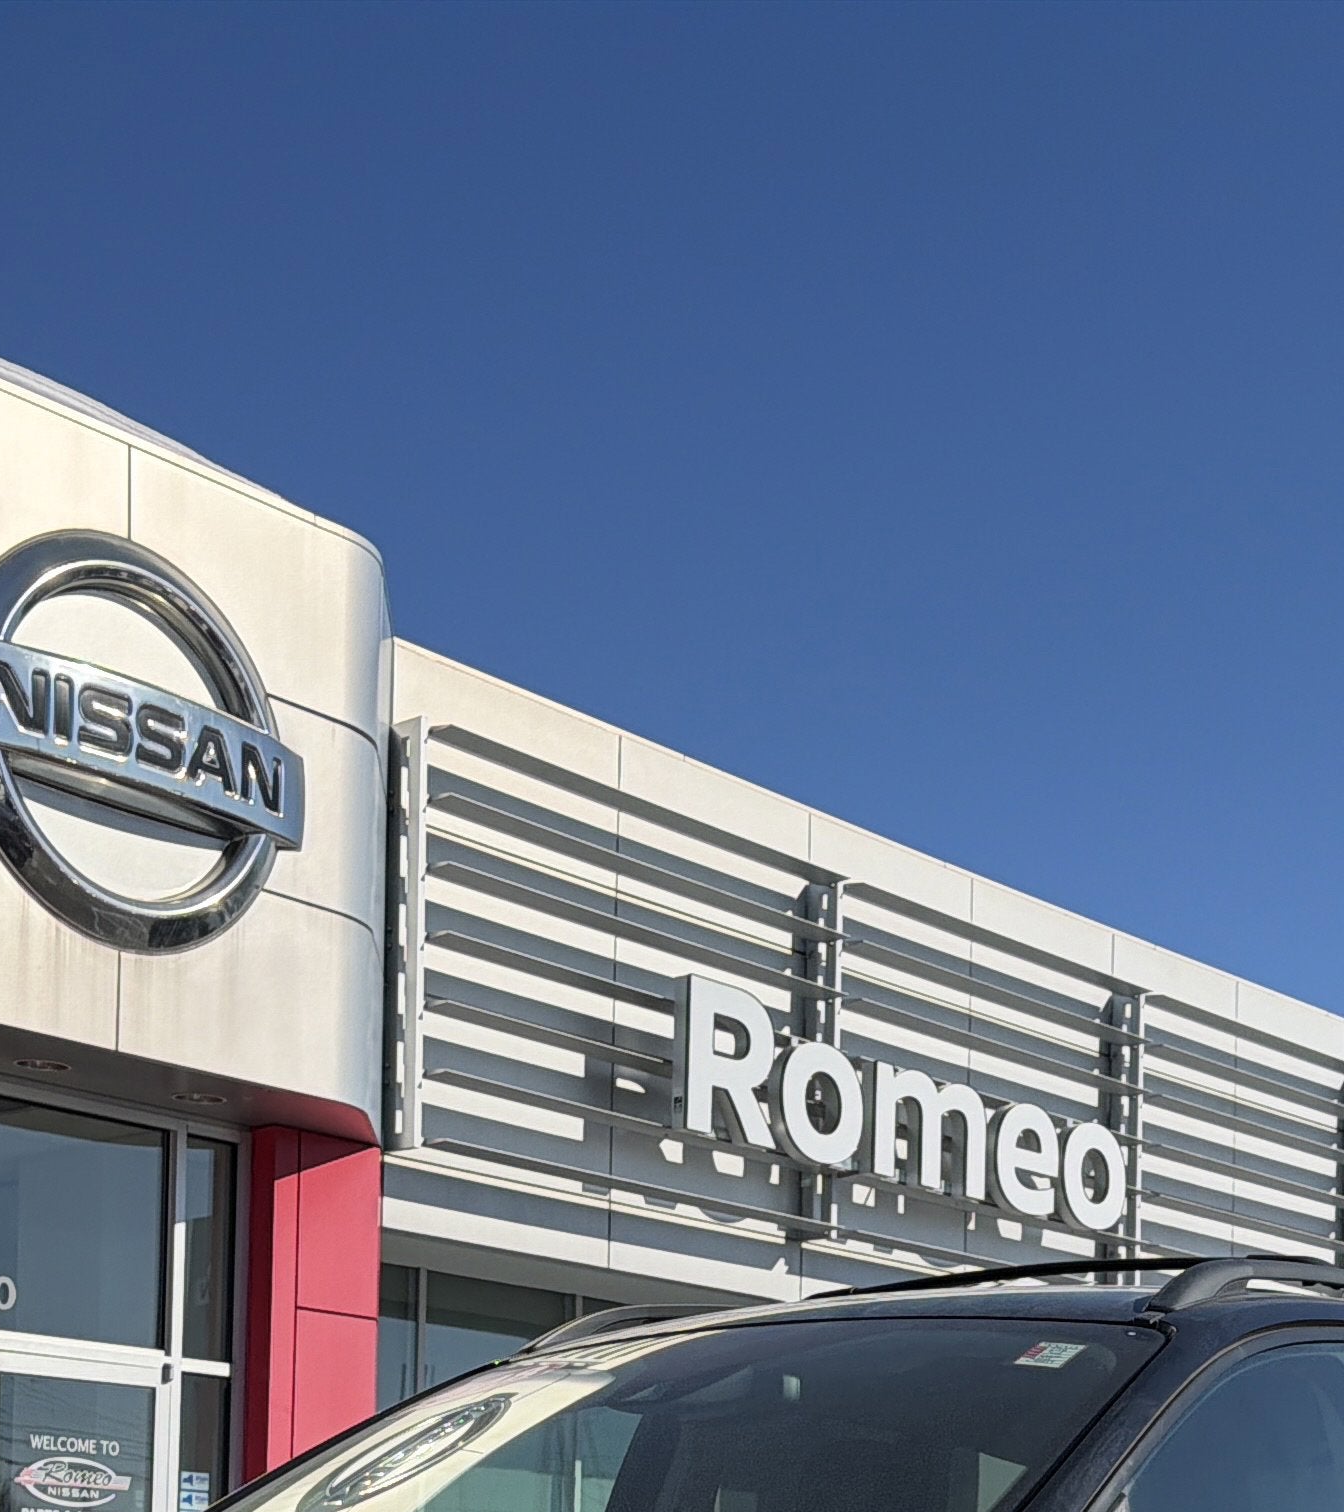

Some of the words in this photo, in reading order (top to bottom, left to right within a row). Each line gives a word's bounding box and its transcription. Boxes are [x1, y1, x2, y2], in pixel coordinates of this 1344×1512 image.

[673, 972, 1127, 1231] Romeo
[30, 1433, 97, 1455] WELCOME
[100, 1440, 120, 1457] TO
[37, 1460, 113, 1486] Romeo
[47, 1487, 100, 1499] NISSAN
